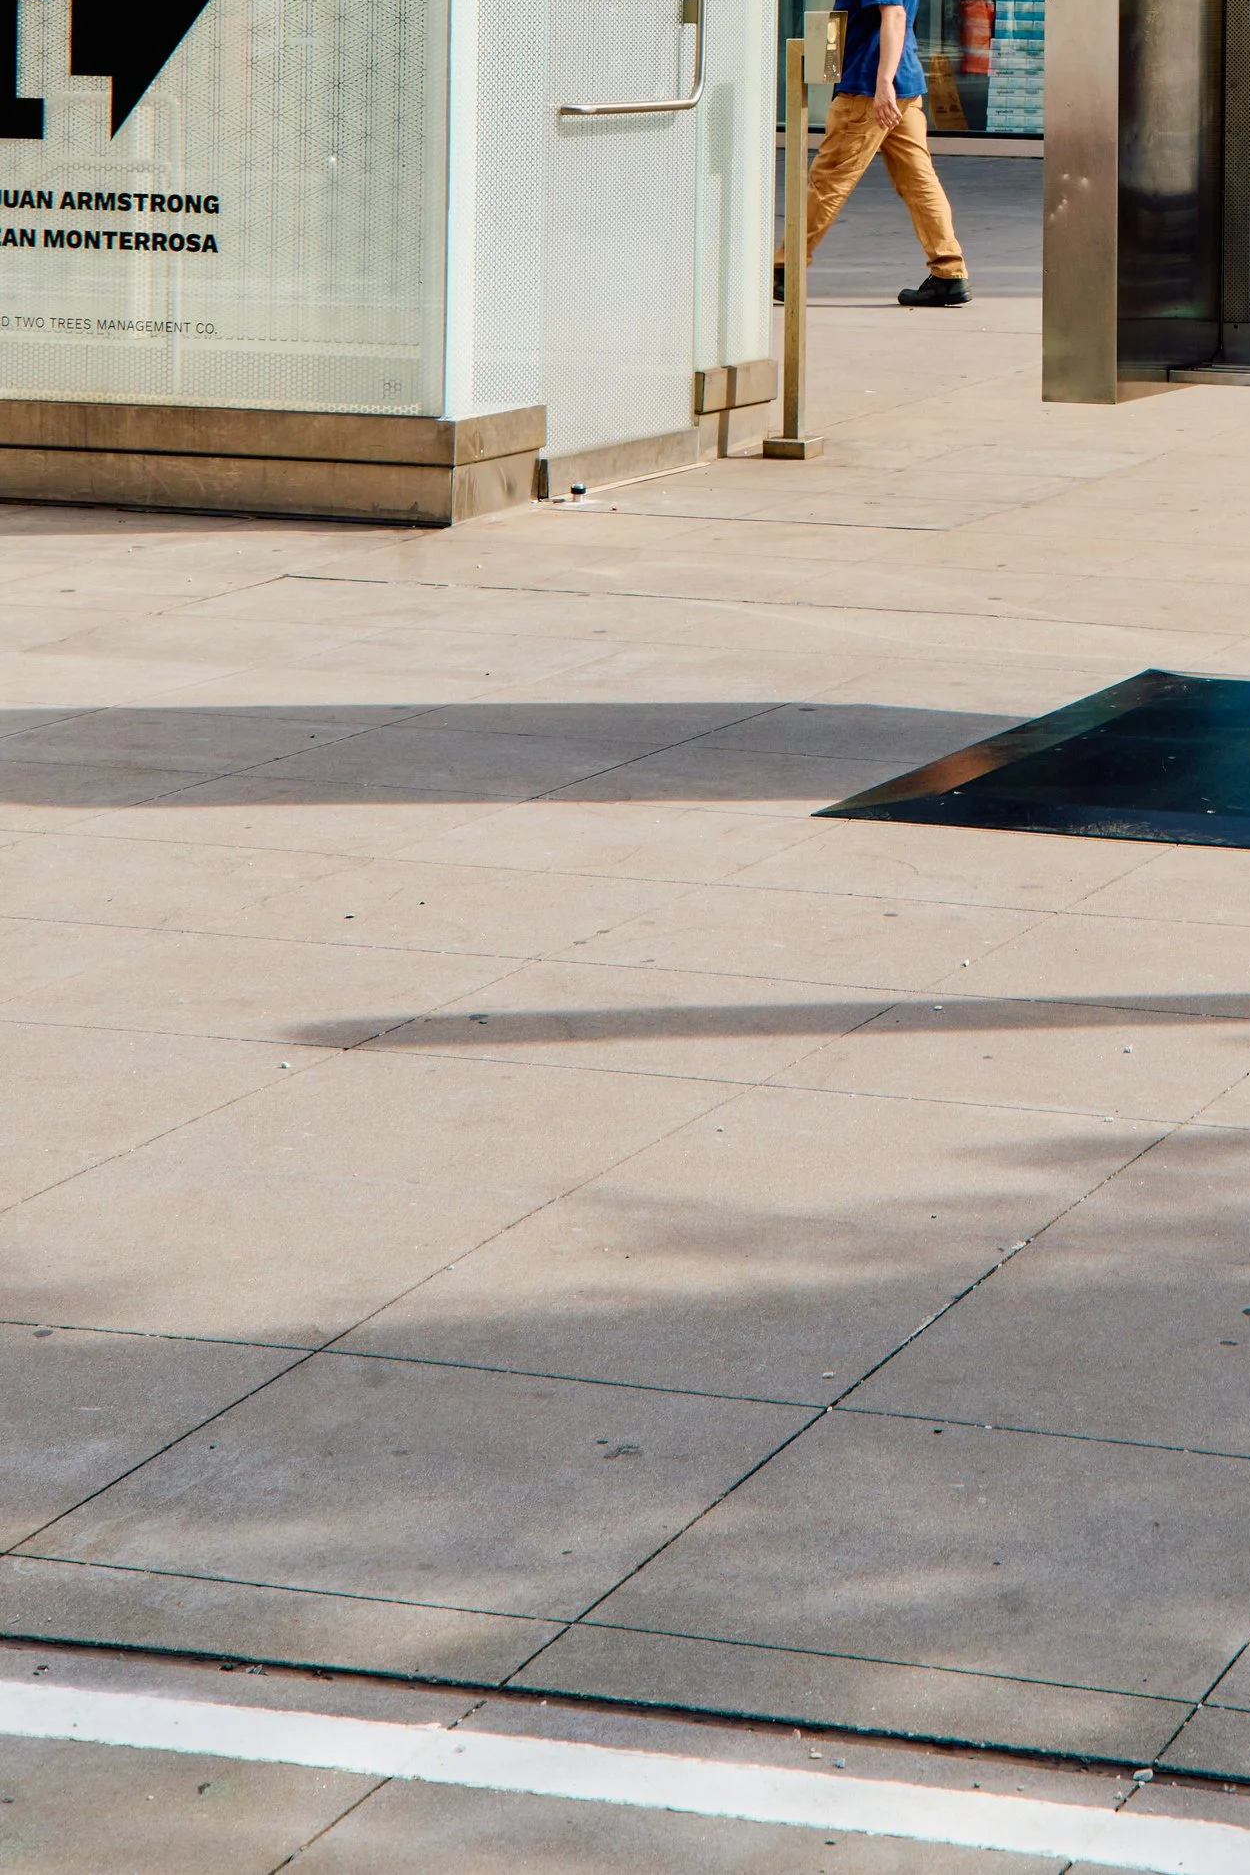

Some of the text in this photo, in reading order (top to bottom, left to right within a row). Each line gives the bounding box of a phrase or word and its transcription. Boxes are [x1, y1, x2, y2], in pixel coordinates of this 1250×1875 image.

[0, 189, 220, 215] UAN ARMSTRONG
[0, 228, 219, 253] AN MONTERROSA
[15, 316, 45, 329] TWO
[50, 317, 92, 330] TREES
[97, 319, 192, 334] MANAGEMENT
[195, 322, 218, 335] CO.
